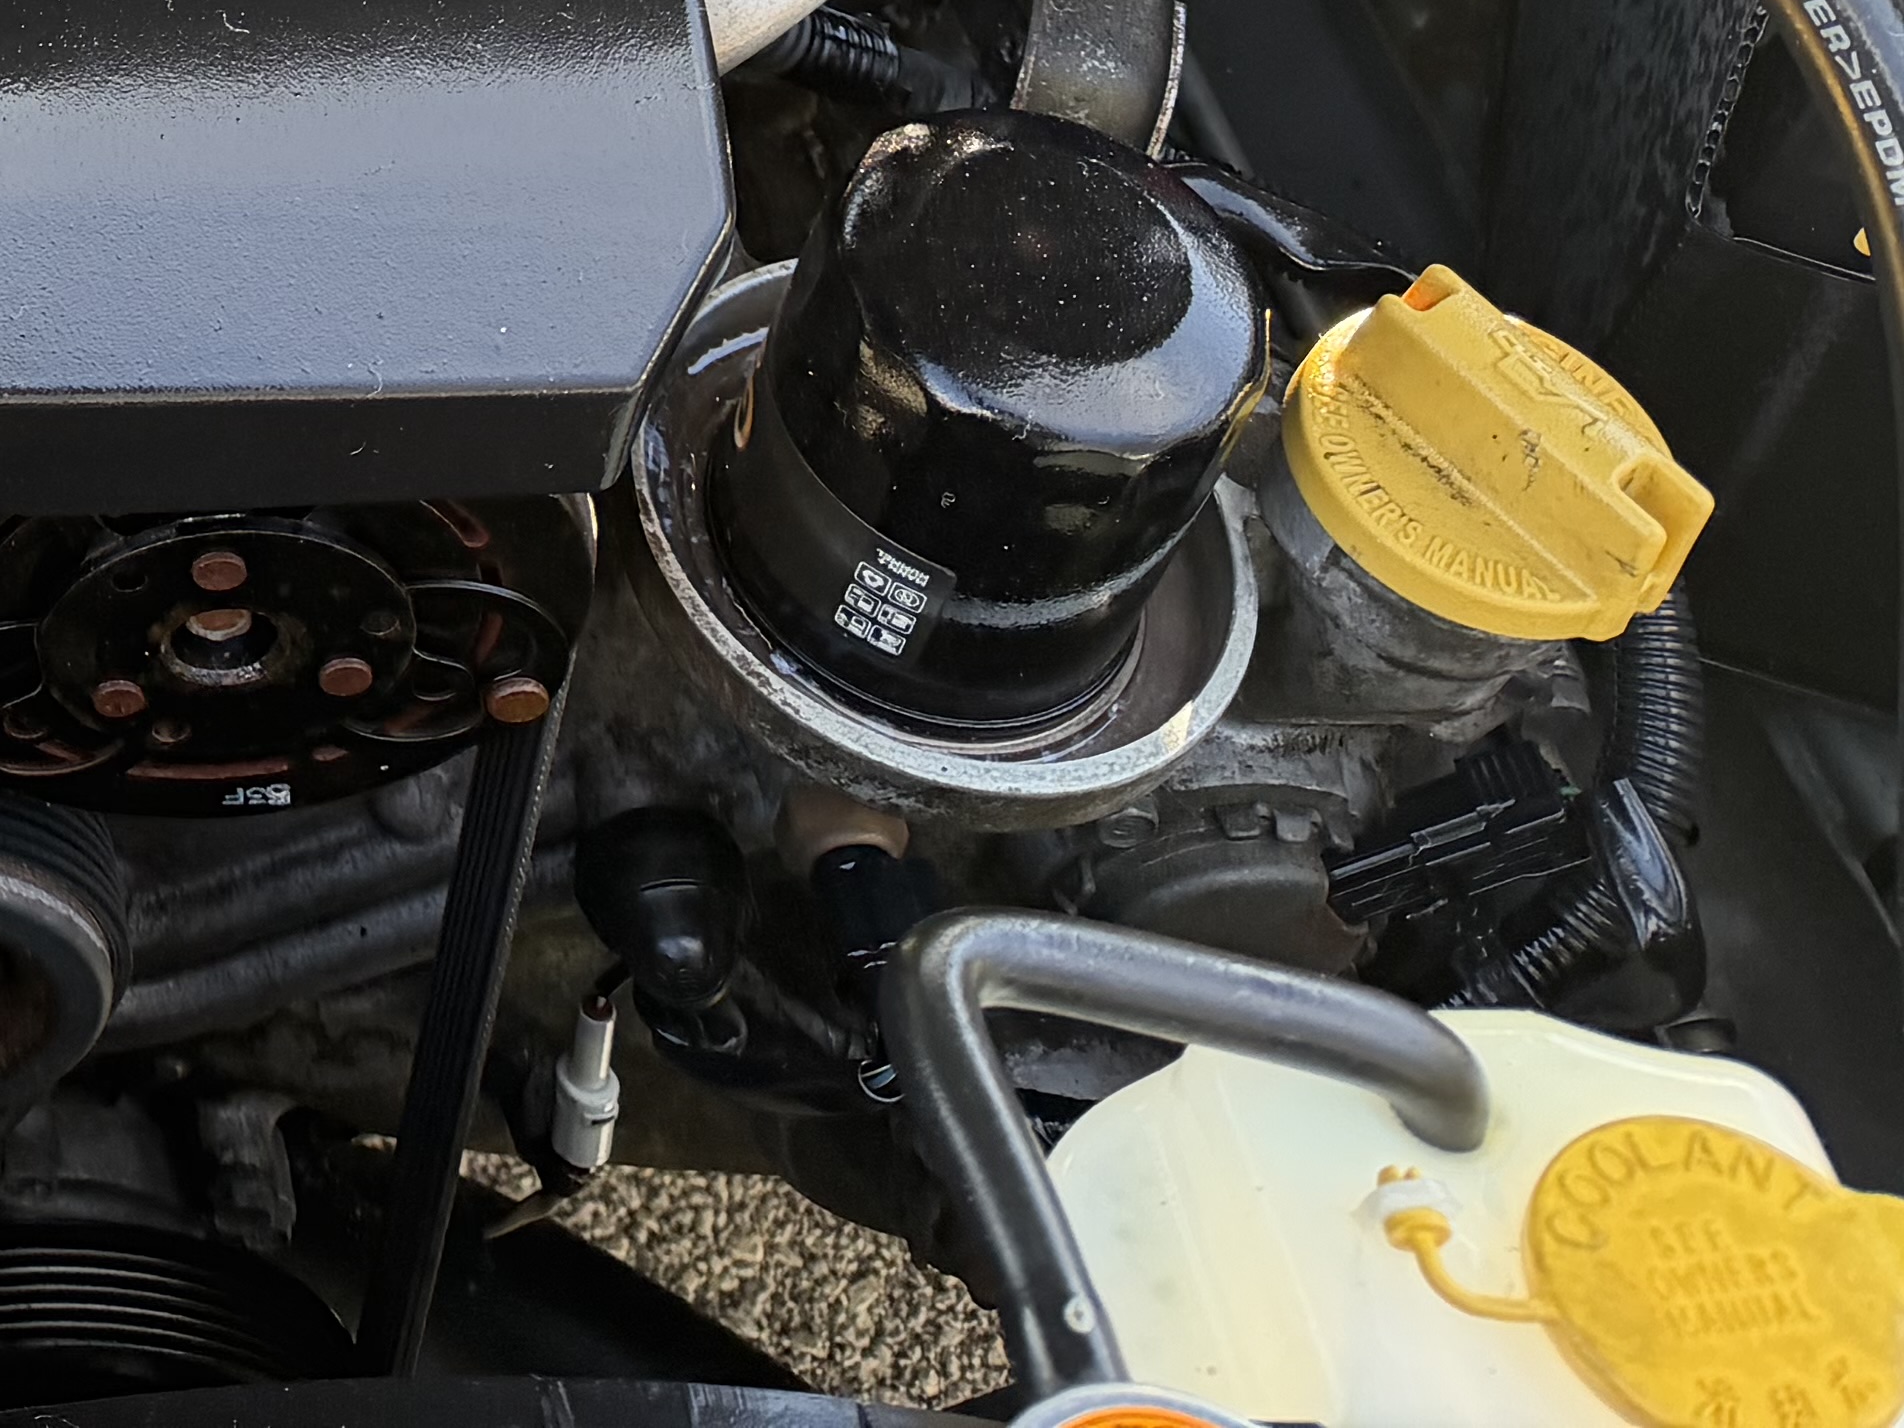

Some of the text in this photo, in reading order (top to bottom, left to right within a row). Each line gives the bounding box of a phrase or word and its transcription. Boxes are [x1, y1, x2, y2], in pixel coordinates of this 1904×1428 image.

[1318, 432, 1425, 546] OWNER'S
[1423, 532, 1560, 603] MANUAL
[1543, 1127, 1830, 1253] COOLANT
[1648, 1216, 1725, 1259] SEE
